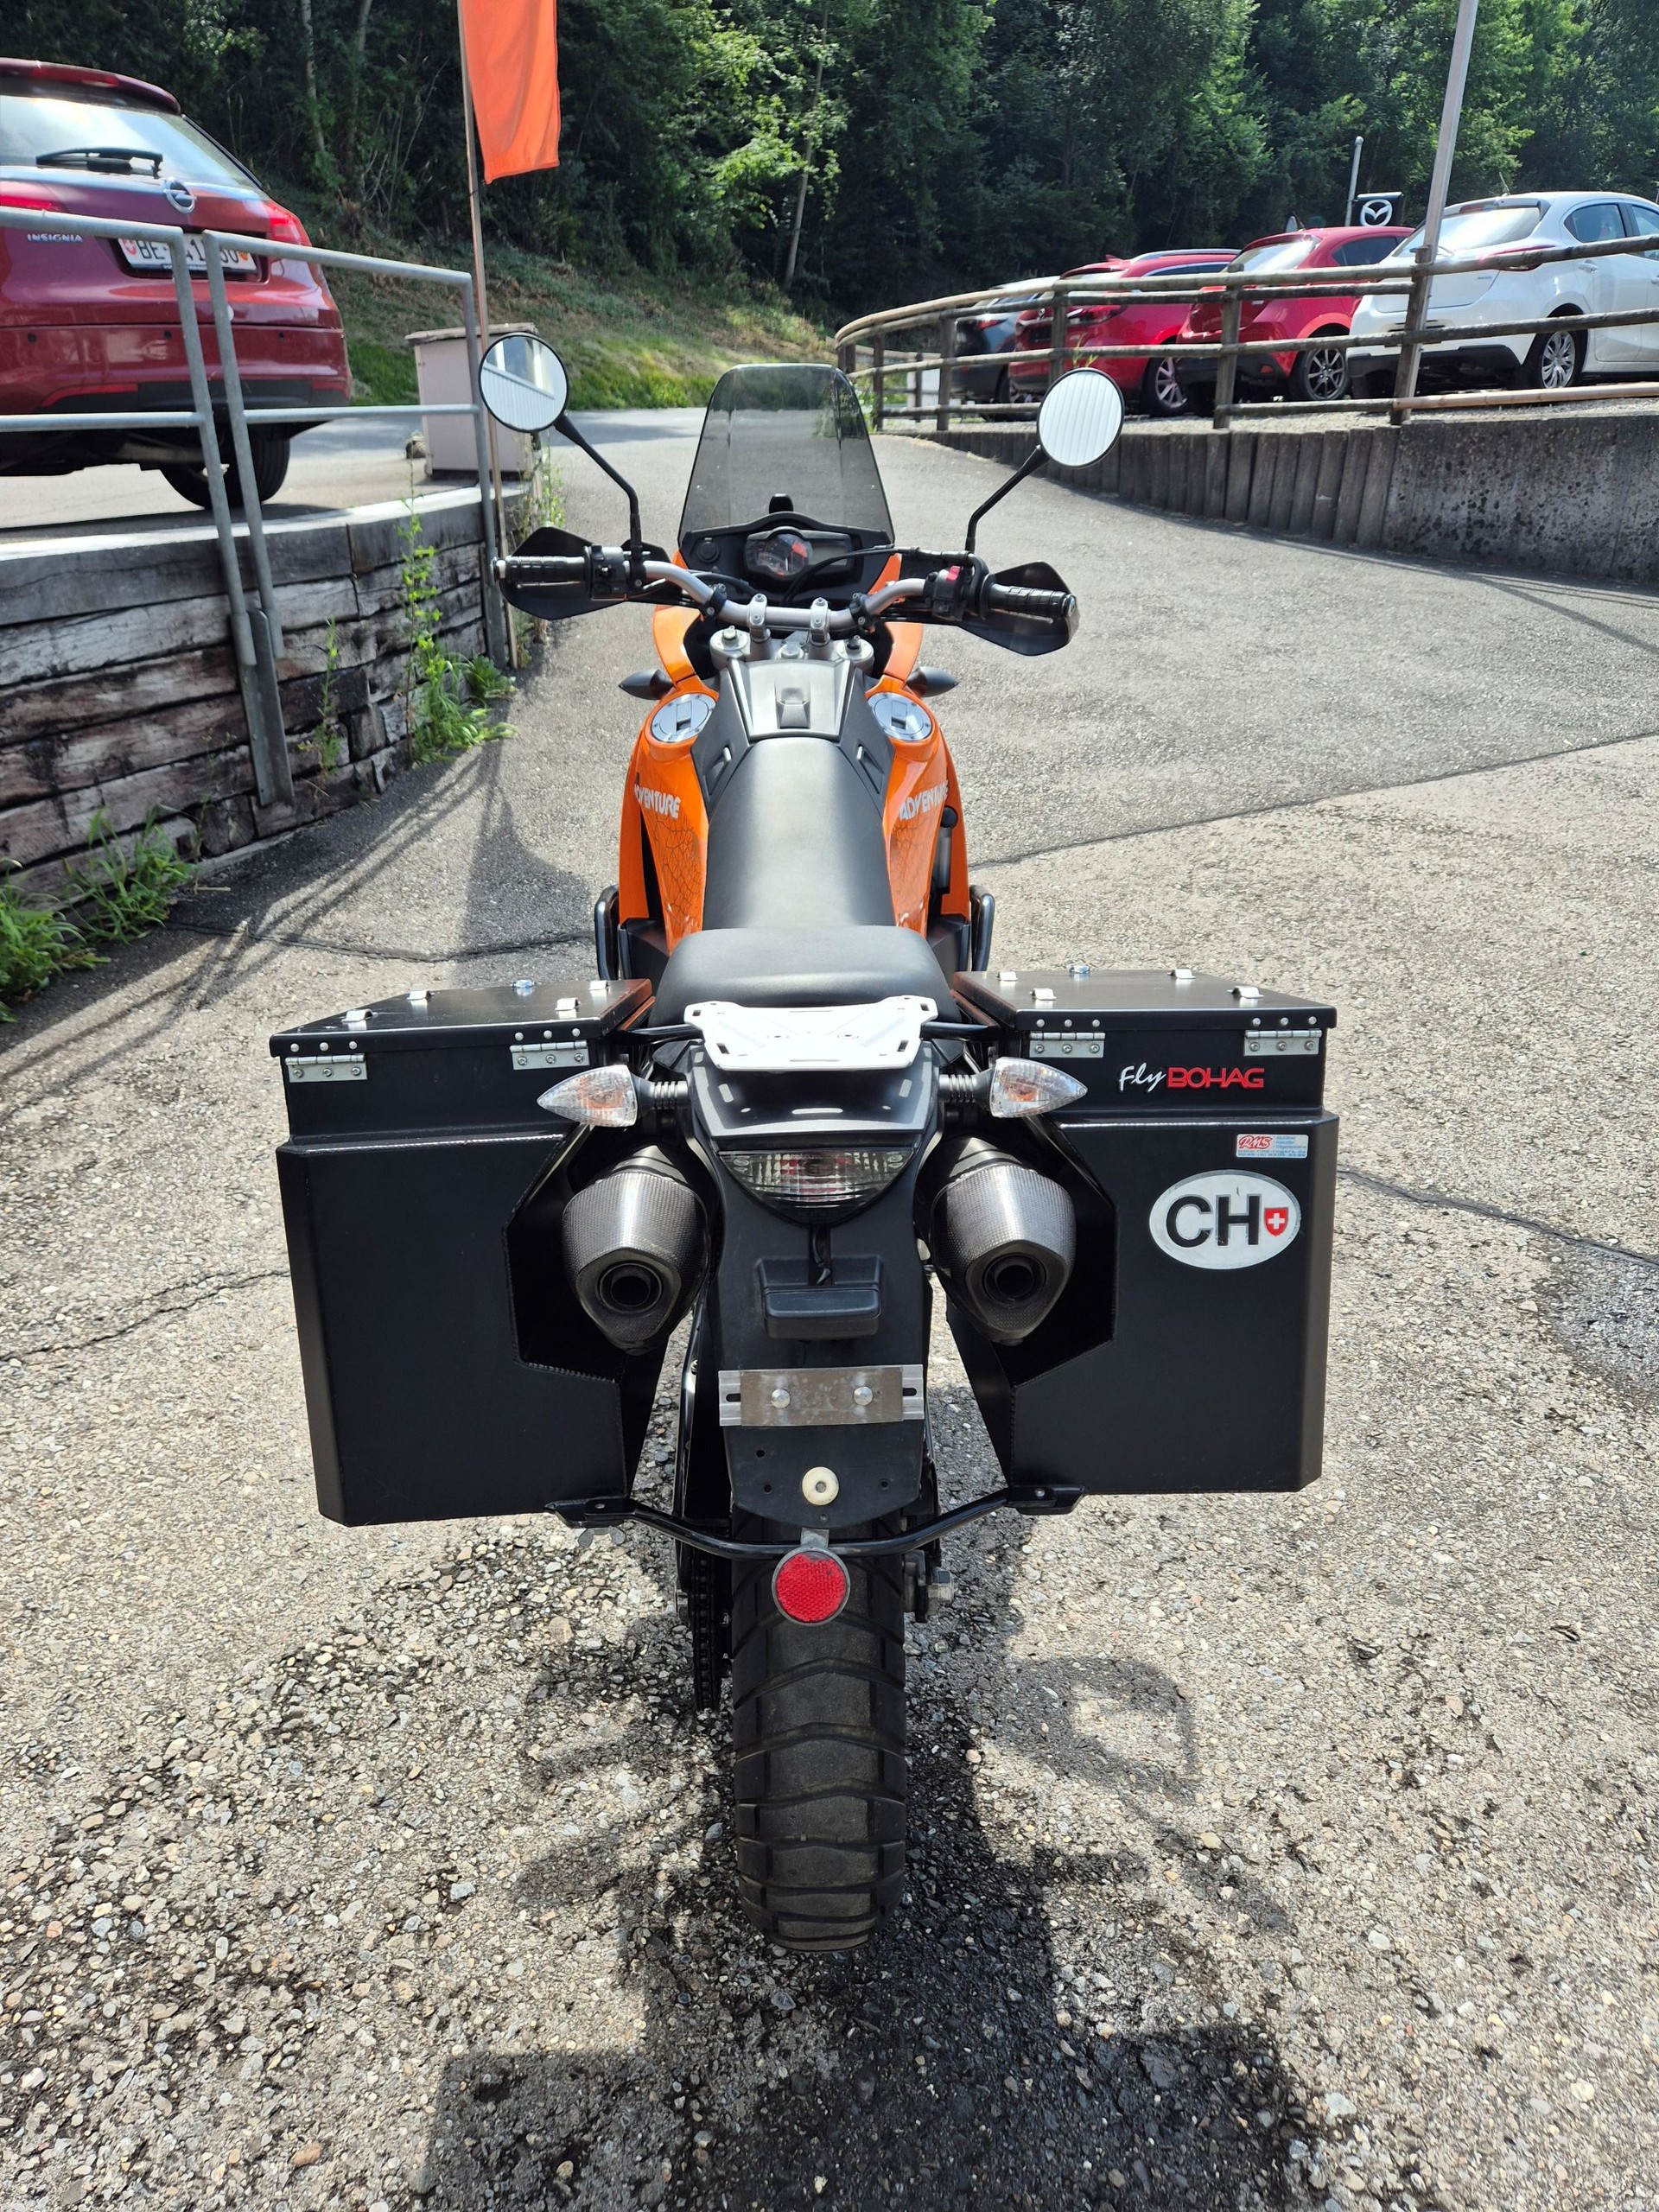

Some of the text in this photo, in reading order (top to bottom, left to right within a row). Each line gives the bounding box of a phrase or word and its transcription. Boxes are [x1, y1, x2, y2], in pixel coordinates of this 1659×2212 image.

[27, 233, 84, 243] INSIGNIA
[1119, 1062, 1265, 1092] Fly BOHAG
[1238, 1135, 1273, 1150] RMS
[1166, 1193, 1262, 1248] CH
